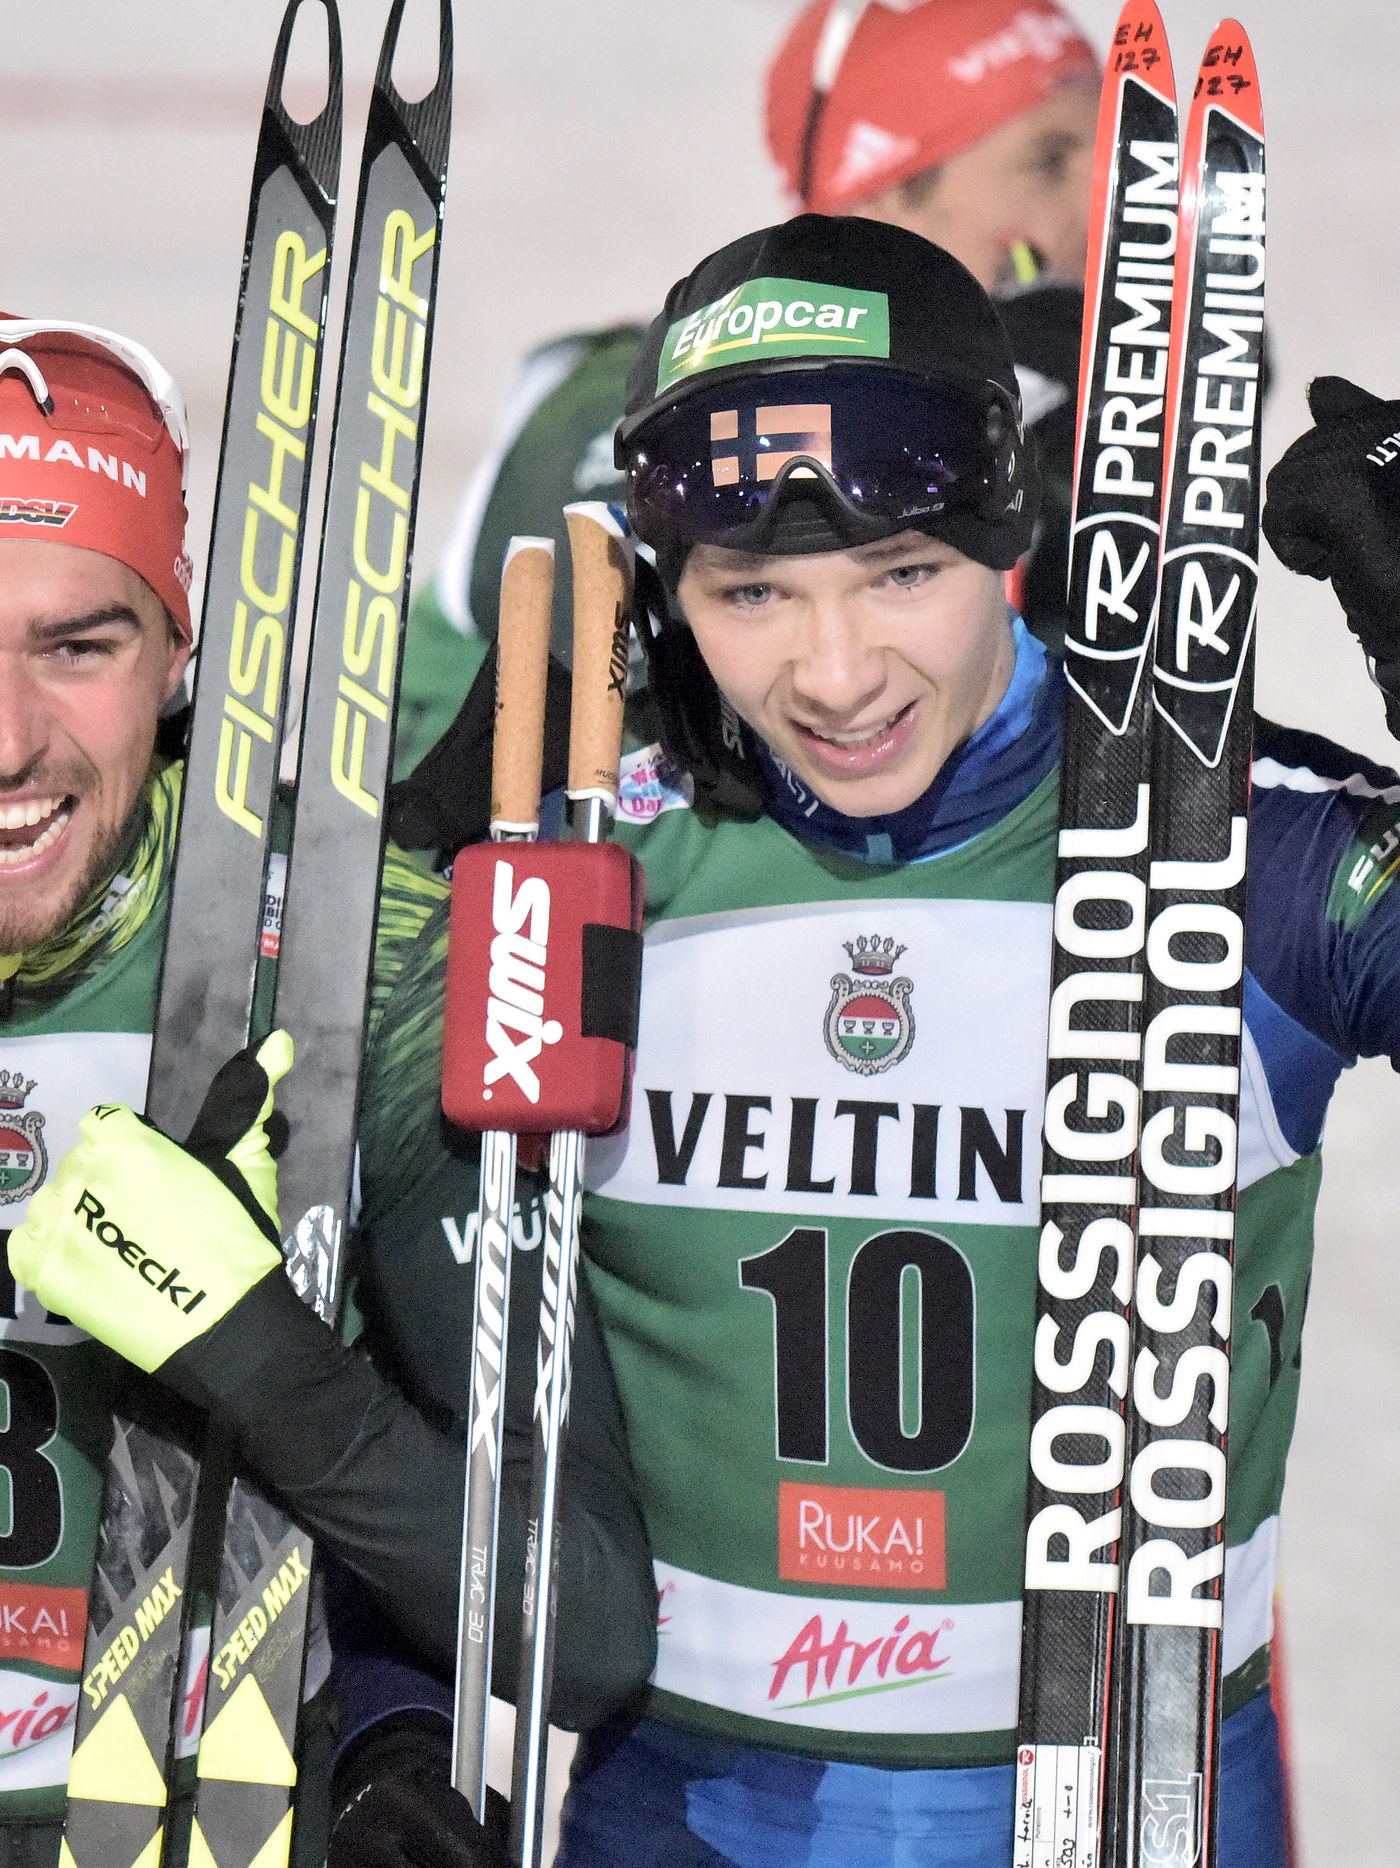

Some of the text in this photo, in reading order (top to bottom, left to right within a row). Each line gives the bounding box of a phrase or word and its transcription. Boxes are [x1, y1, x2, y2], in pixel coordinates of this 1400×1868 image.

[1113, 48, 1161, 72] 127
[1194, 75, 1251, 99] 127
[672, 294, 868, 360] Europcar
[1094, 141, 1179, 497] PREMIUM
[1182, 172, 1266, 530] PREMIUM
[215, 230, 327, 838] FISCHER
[330, 209, 436, 818] FISCHER
[644, 1089, 1027, 1204] VELTIN
[1025, 783, 1149, 1592] ROSSIGNOL
[1126, 816, 1247, 1628] ROSSIGNOL
[738, 1226, 977, 1473] 10
[800, 1500, 923, 1556] RUKA!
[83, 1625, 140, 1711] SPEED
[135, 1566, 182, 1641] MAX
[211, 1606, 268, 1691] SPEED
[262, 1546, 310, 1622] MAX
[767, 1615, 951, 1701] Atria
